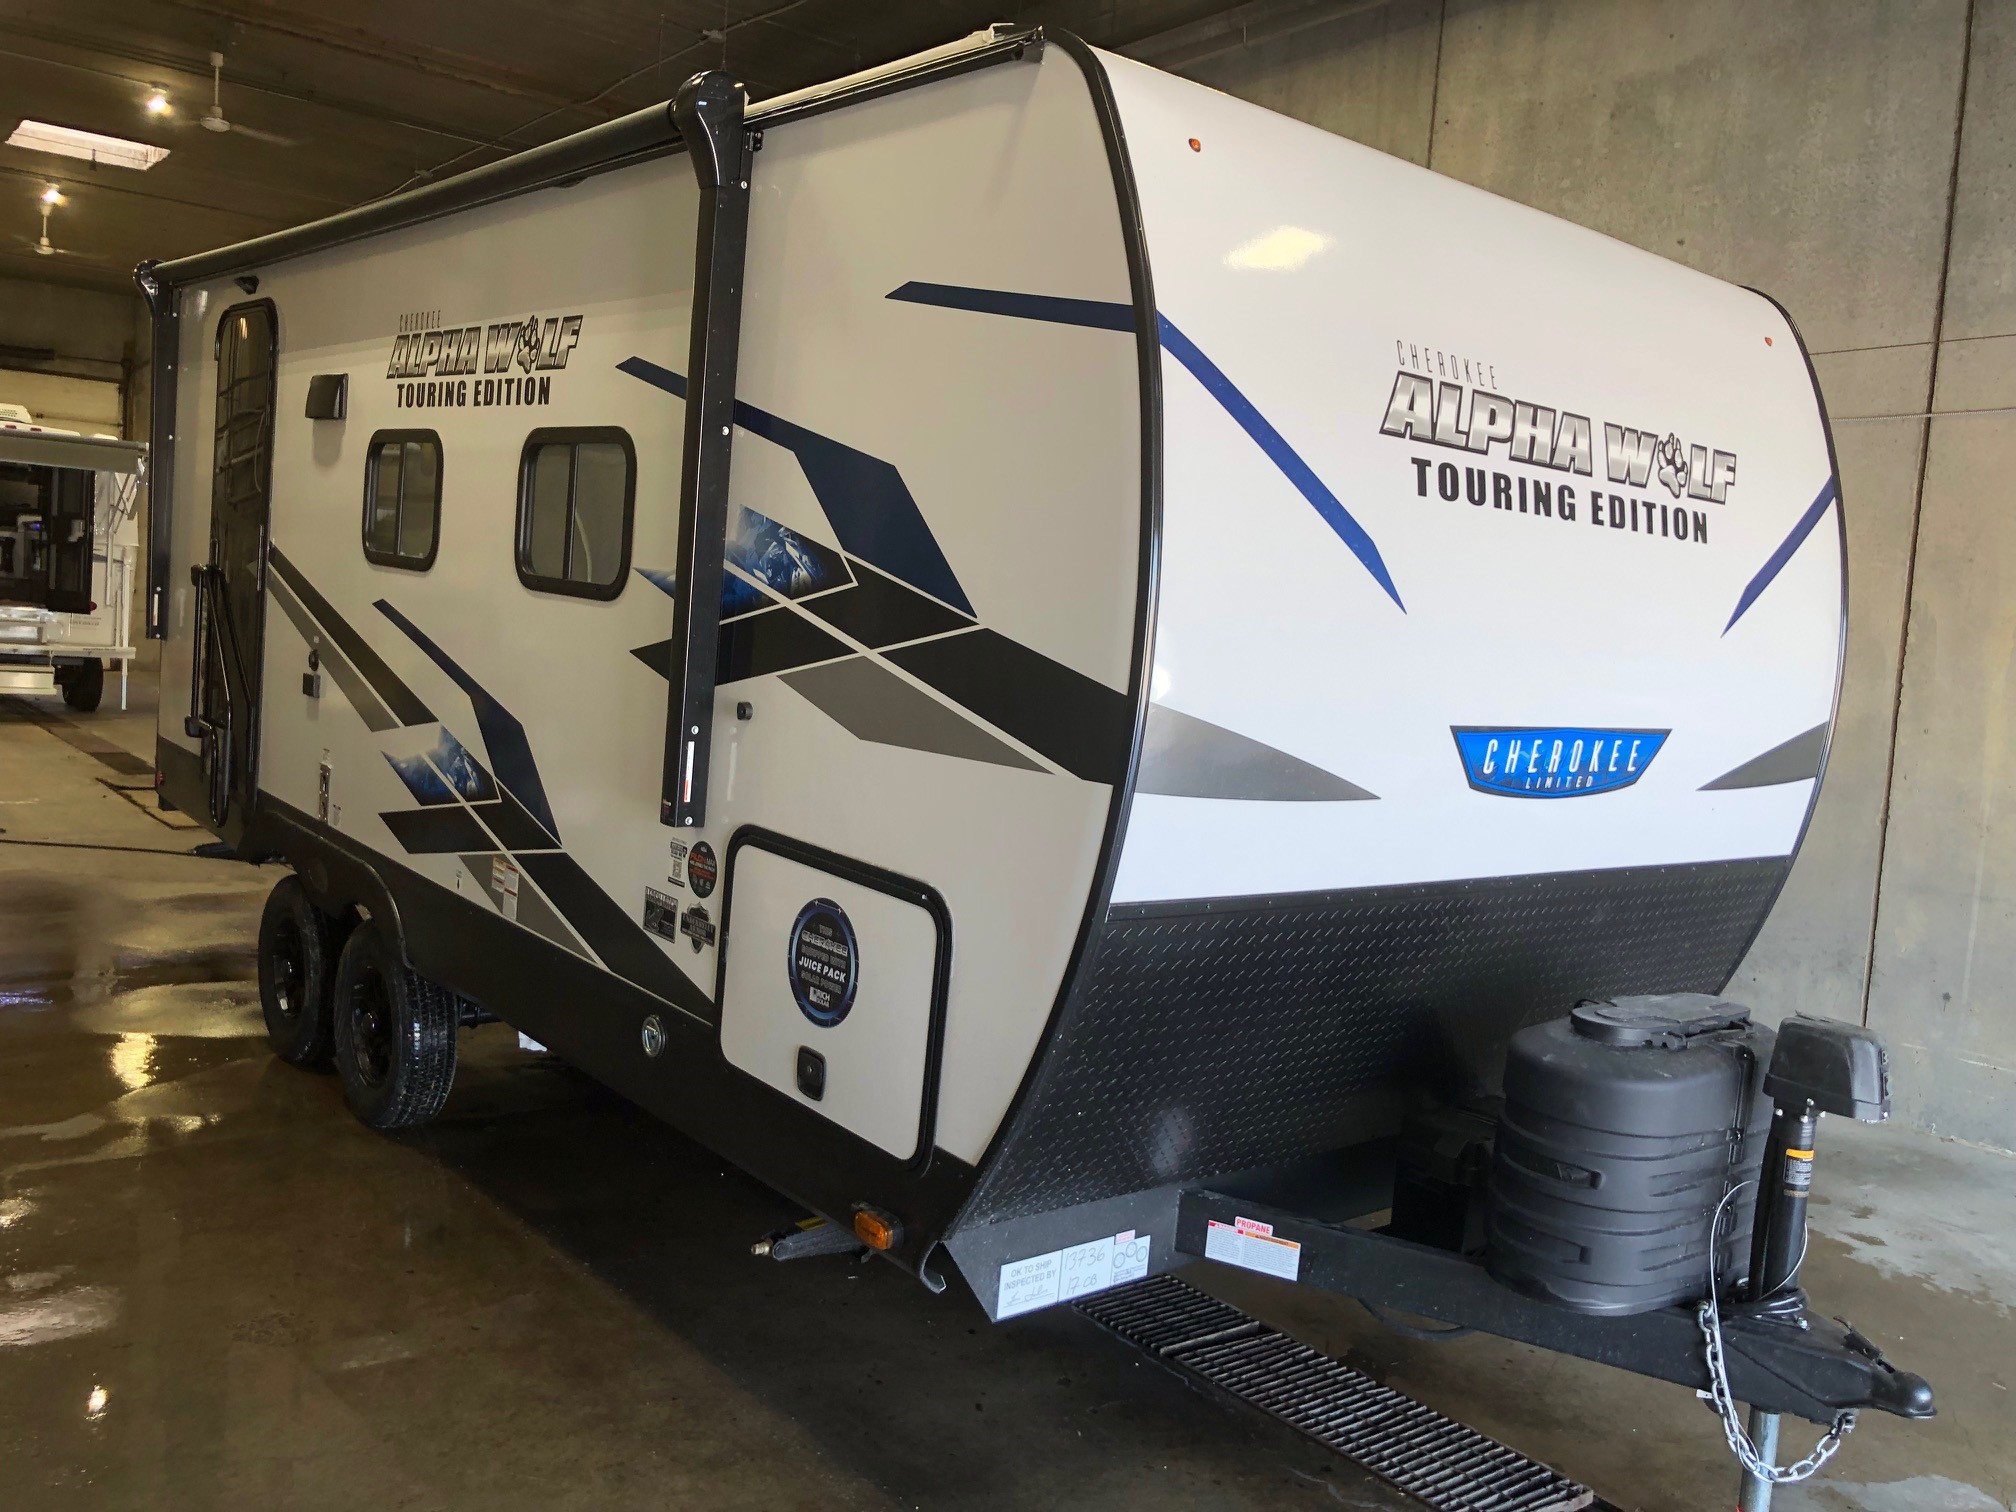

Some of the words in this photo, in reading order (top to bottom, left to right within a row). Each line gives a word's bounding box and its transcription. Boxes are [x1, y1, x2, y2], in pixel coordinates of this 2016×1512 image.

[386, 326, 482, 379] ALPHA
[1396, 340, 1498, 390] CHEROKEE
[397, 380, 467, 408] TOURING
[473, 376, 551, 407] EDITION
[1379, 370, 1594, 477] ALPHA
[1410, 456, 1577, 522] TOURING
[1590, 490, 1708, 544] EDITION
[1482, 738, 1642, 775] CHEROKEE
[1525, 775, 1594, 790] LIMITED
[799, 956, 822, 974] JUICE
[822, 965, 847, 983] PACK
[1236, 1218, 1271, 1235] PROPANE
[1004, 1272, 1046, 1291] INSPECTED
[1047, 1269, 1057, 1279] BY
[1011, 1267, 1022, 1278] OK
[1024, 1264, 1034, 1275] TO
[1035, 1259, 1053, 1272] SHIP
